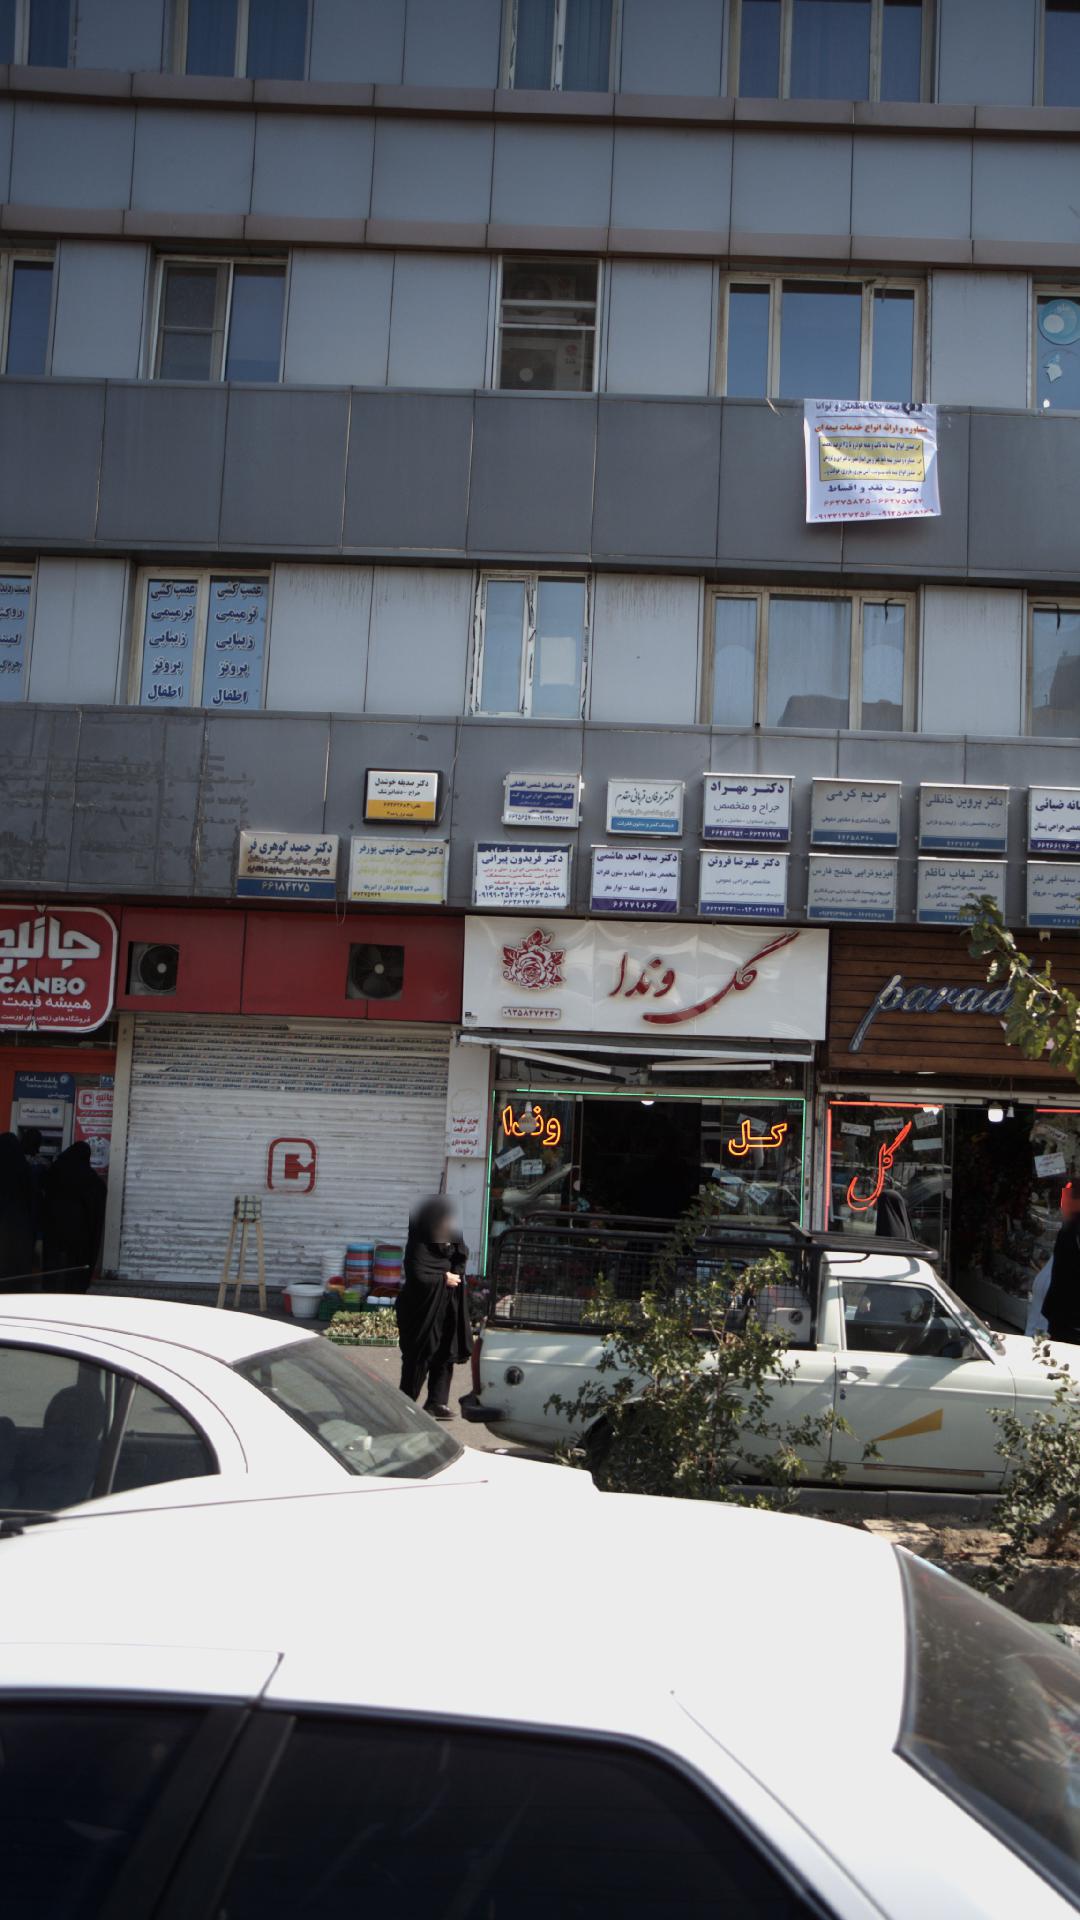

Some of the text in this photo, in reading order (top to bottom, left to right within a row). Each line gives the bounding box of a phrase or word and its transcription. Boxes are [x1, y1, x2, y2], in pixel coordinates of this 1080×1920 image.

[864, 424, 880, 435] انواع
[828, 484, 856, 492] اقساط
[151, 582, 196, 600] عصب کشی
[217, 582, 263, 600] عصب کشی
[151, 606, 194, 623] ترمیمی
[216, 607, 257, 623] ترمیمی
[149, 630, 188, 649] زیبایی
[216, 633, 255, 651] زیبایی
[148, 685, 182, 700] اطفال
[212, 689, 248, 705] اطفال
[711, 780, 784, 796] دکتر مهراد
[826, 788, 887, 802] مریم کرمی
[714, 801, 780, 815] جراح و متخصص
[957, 797, 982, 809] پرویز
[984, 796, 1003, 810] دکتر
[248, 838, 333, 856] دکتر حمید گوهری فر
[510, 853, 542, 864] فریدون
[544, 854, 562, 864] دکتر
[597, 852, 623, 862] هاشمی
[643, 853, 658, 863] سید
[659, 853, 677, 863] دکتر
[708, 856, 780, 869] دکتر علیرضا فروتن
[949, 868, 975, 880] شهاب
[978, 870, 999, 881] دکتر
[608, 930, 801, 1025] گل وندا
[0, 977, 86, 995] CANBO
[2, 995, 91, 1012] همیشه قیمت
[728, 1120, 788, 1156] گل
[846, 1120, 913, 1212] گل
